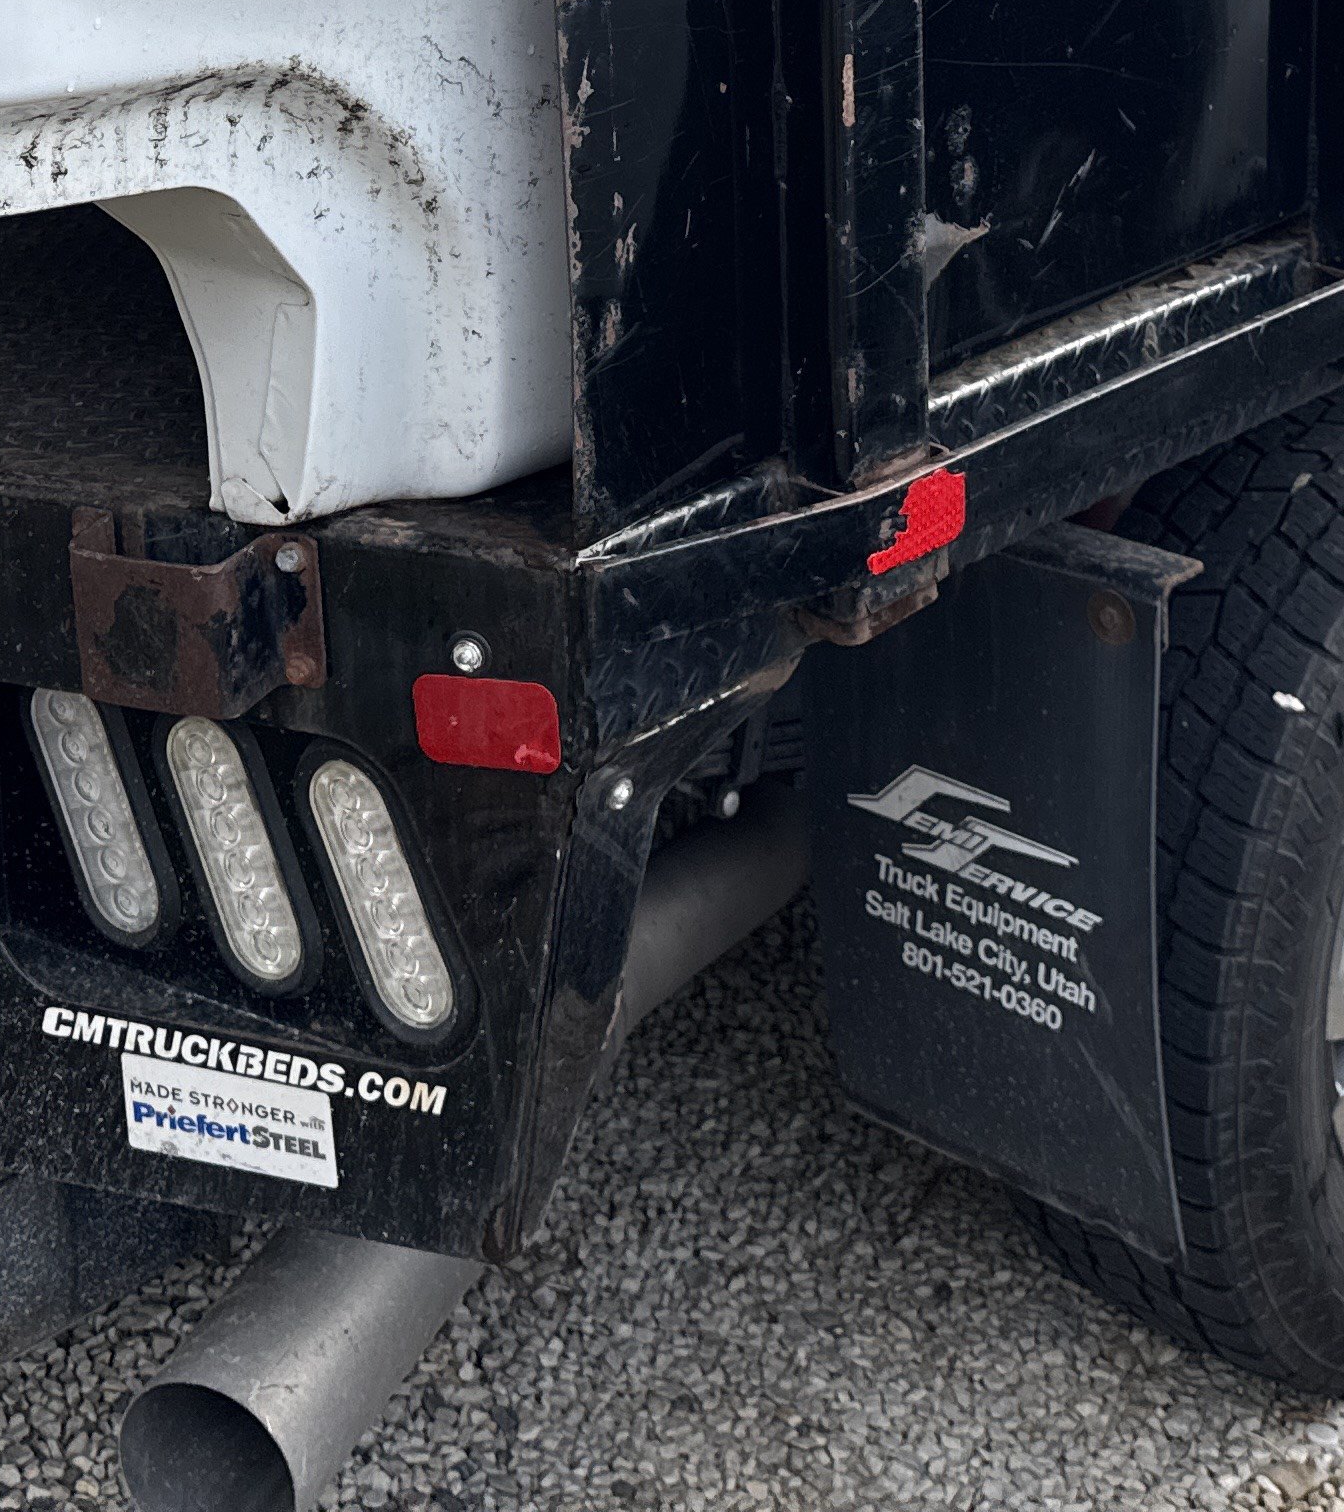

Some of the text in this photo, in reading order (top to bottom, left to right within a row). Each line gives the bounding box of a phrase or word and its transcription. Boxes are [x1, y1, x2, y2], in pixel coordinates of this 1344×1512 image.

[865, 889, 1096, 1014] Salt Lake City, Utah
[873, 853, 1079, 963] Truck Equipment
[902, 941, 1063, 1032] 801-521-0360
[41, 1006, 448, 1116] CMTRUCKBEDS.COM
[129, 1078, 182, 1103] MADE
